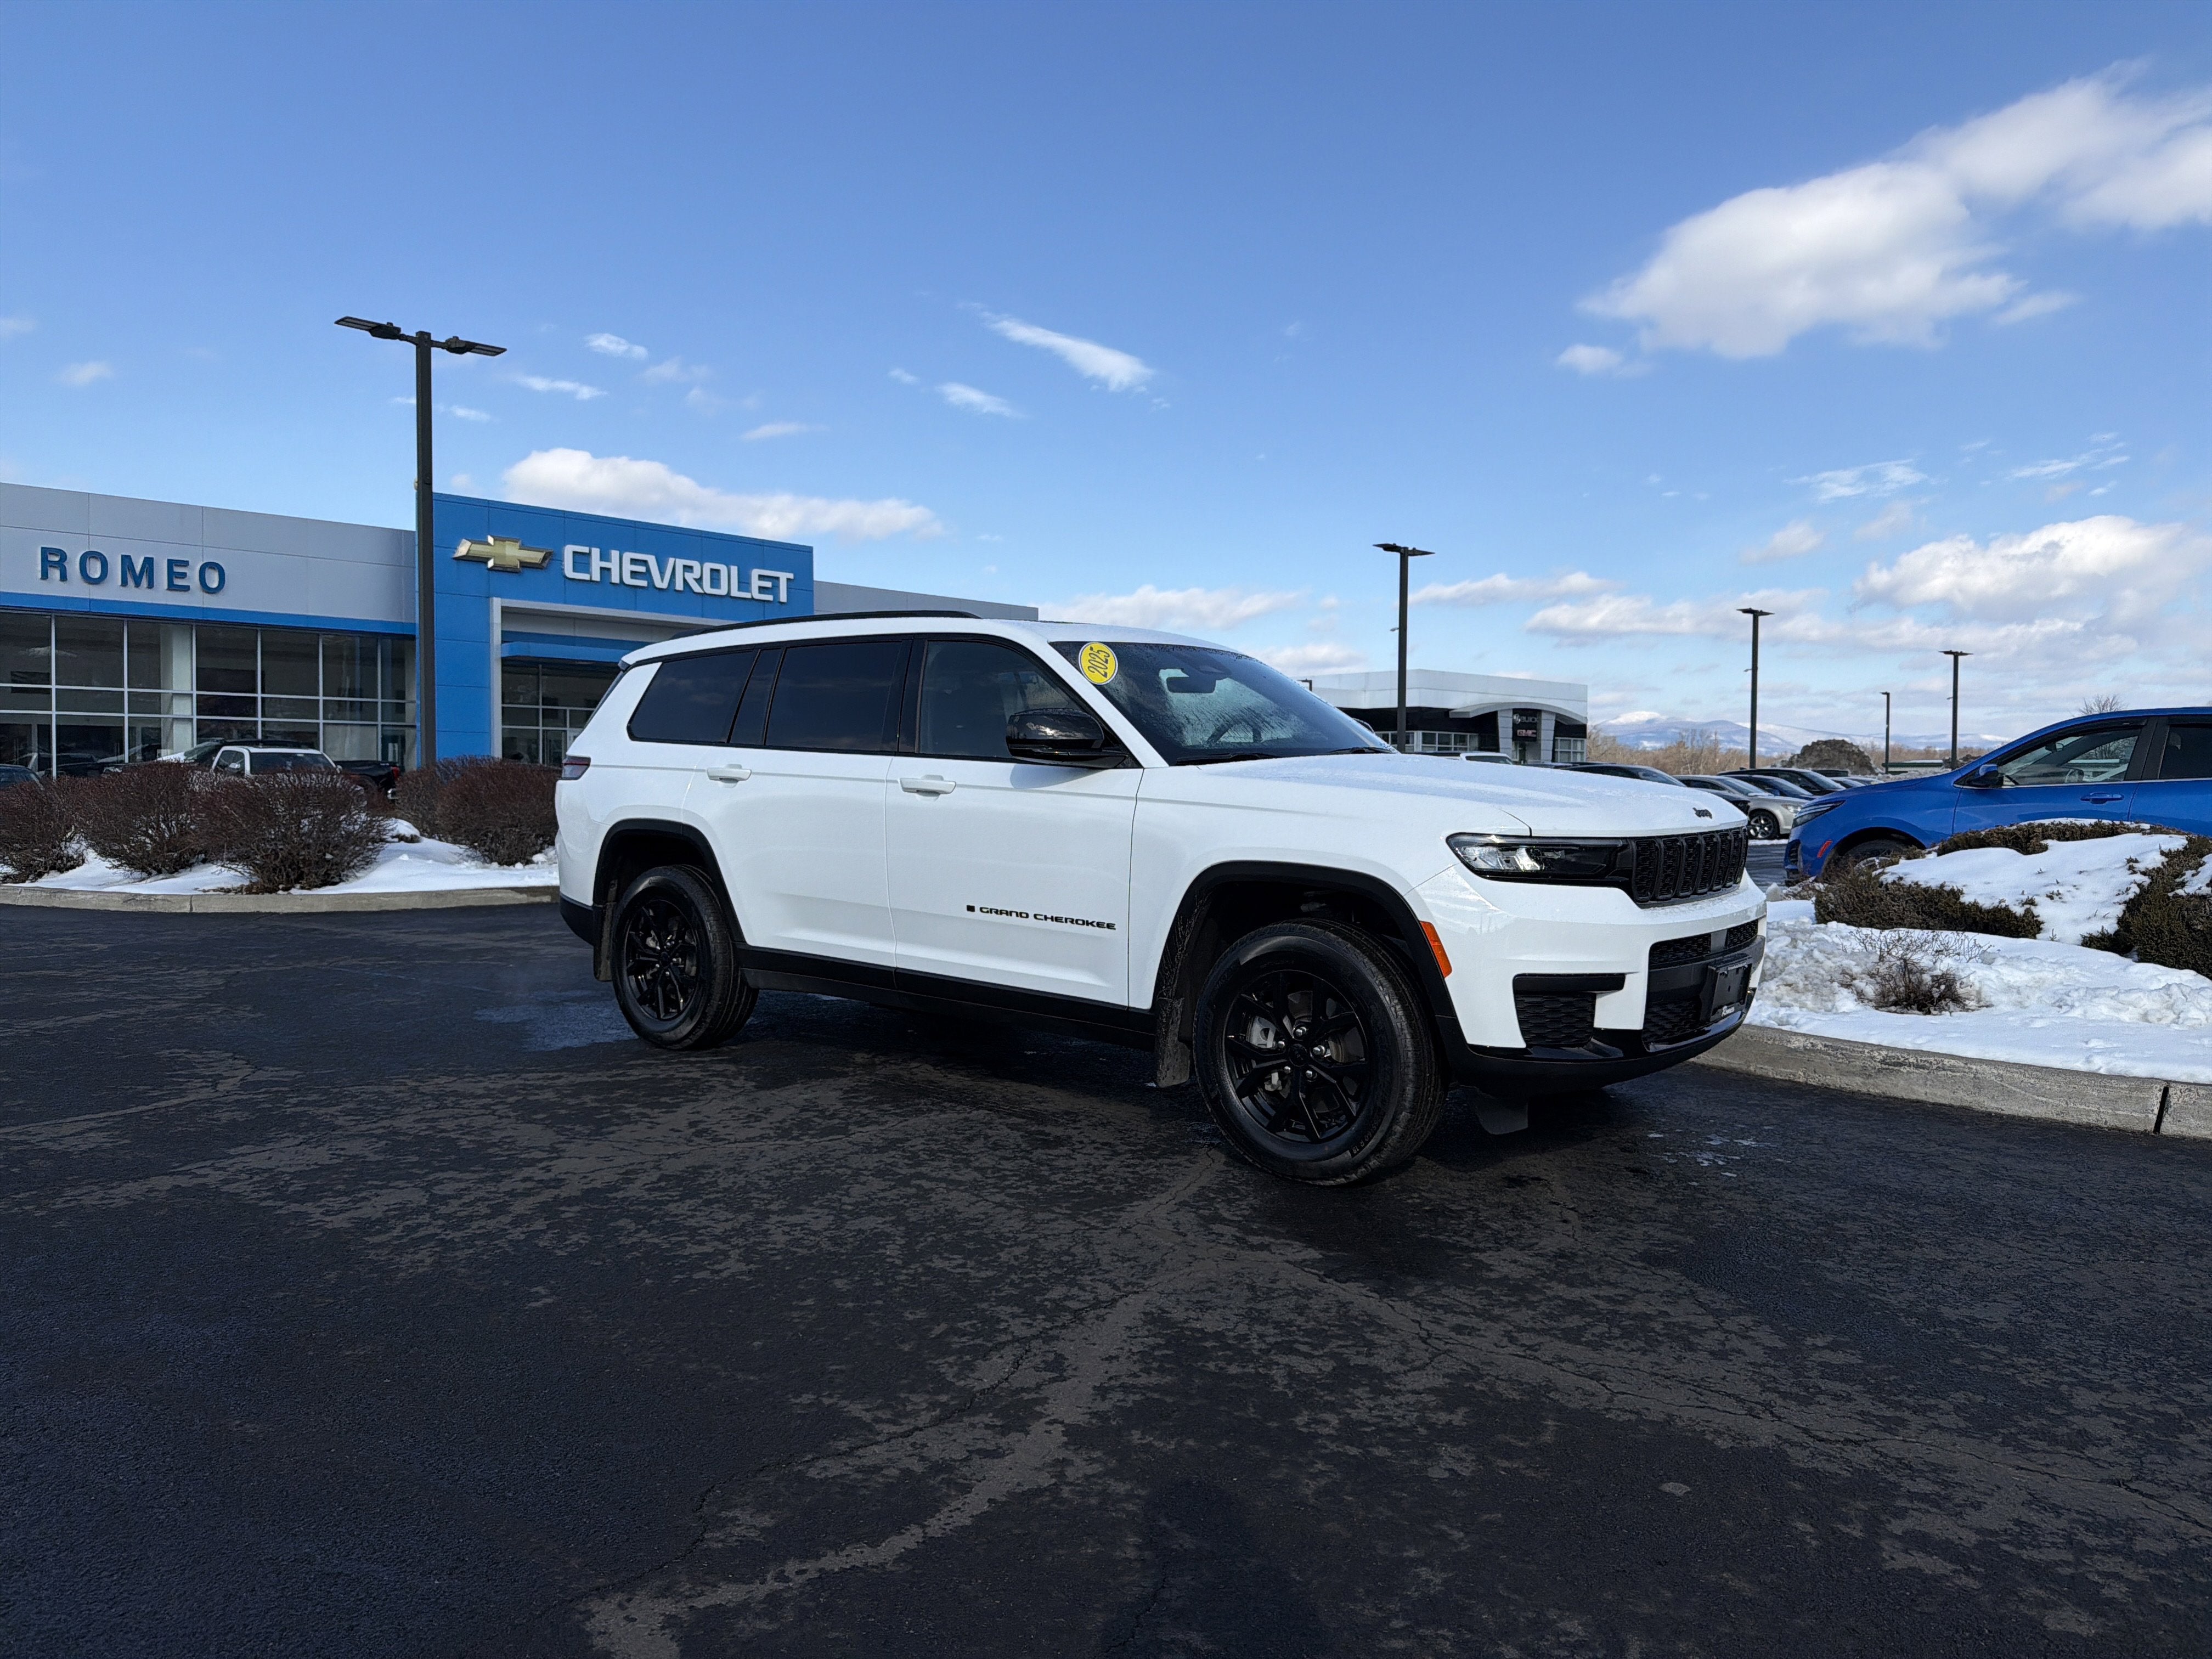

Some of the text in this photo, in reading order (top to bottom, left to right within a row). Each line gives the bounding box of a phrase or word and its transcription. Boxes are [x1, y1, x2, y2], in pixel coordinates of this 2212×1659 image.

[41, 546, 225, 594] ROMEO
[564, 544, 794, 603] CHEVROLET
[1087, 646, 1110, 678] 2025
[979, 907, 1116, 930] GRAND CHEROKEE
